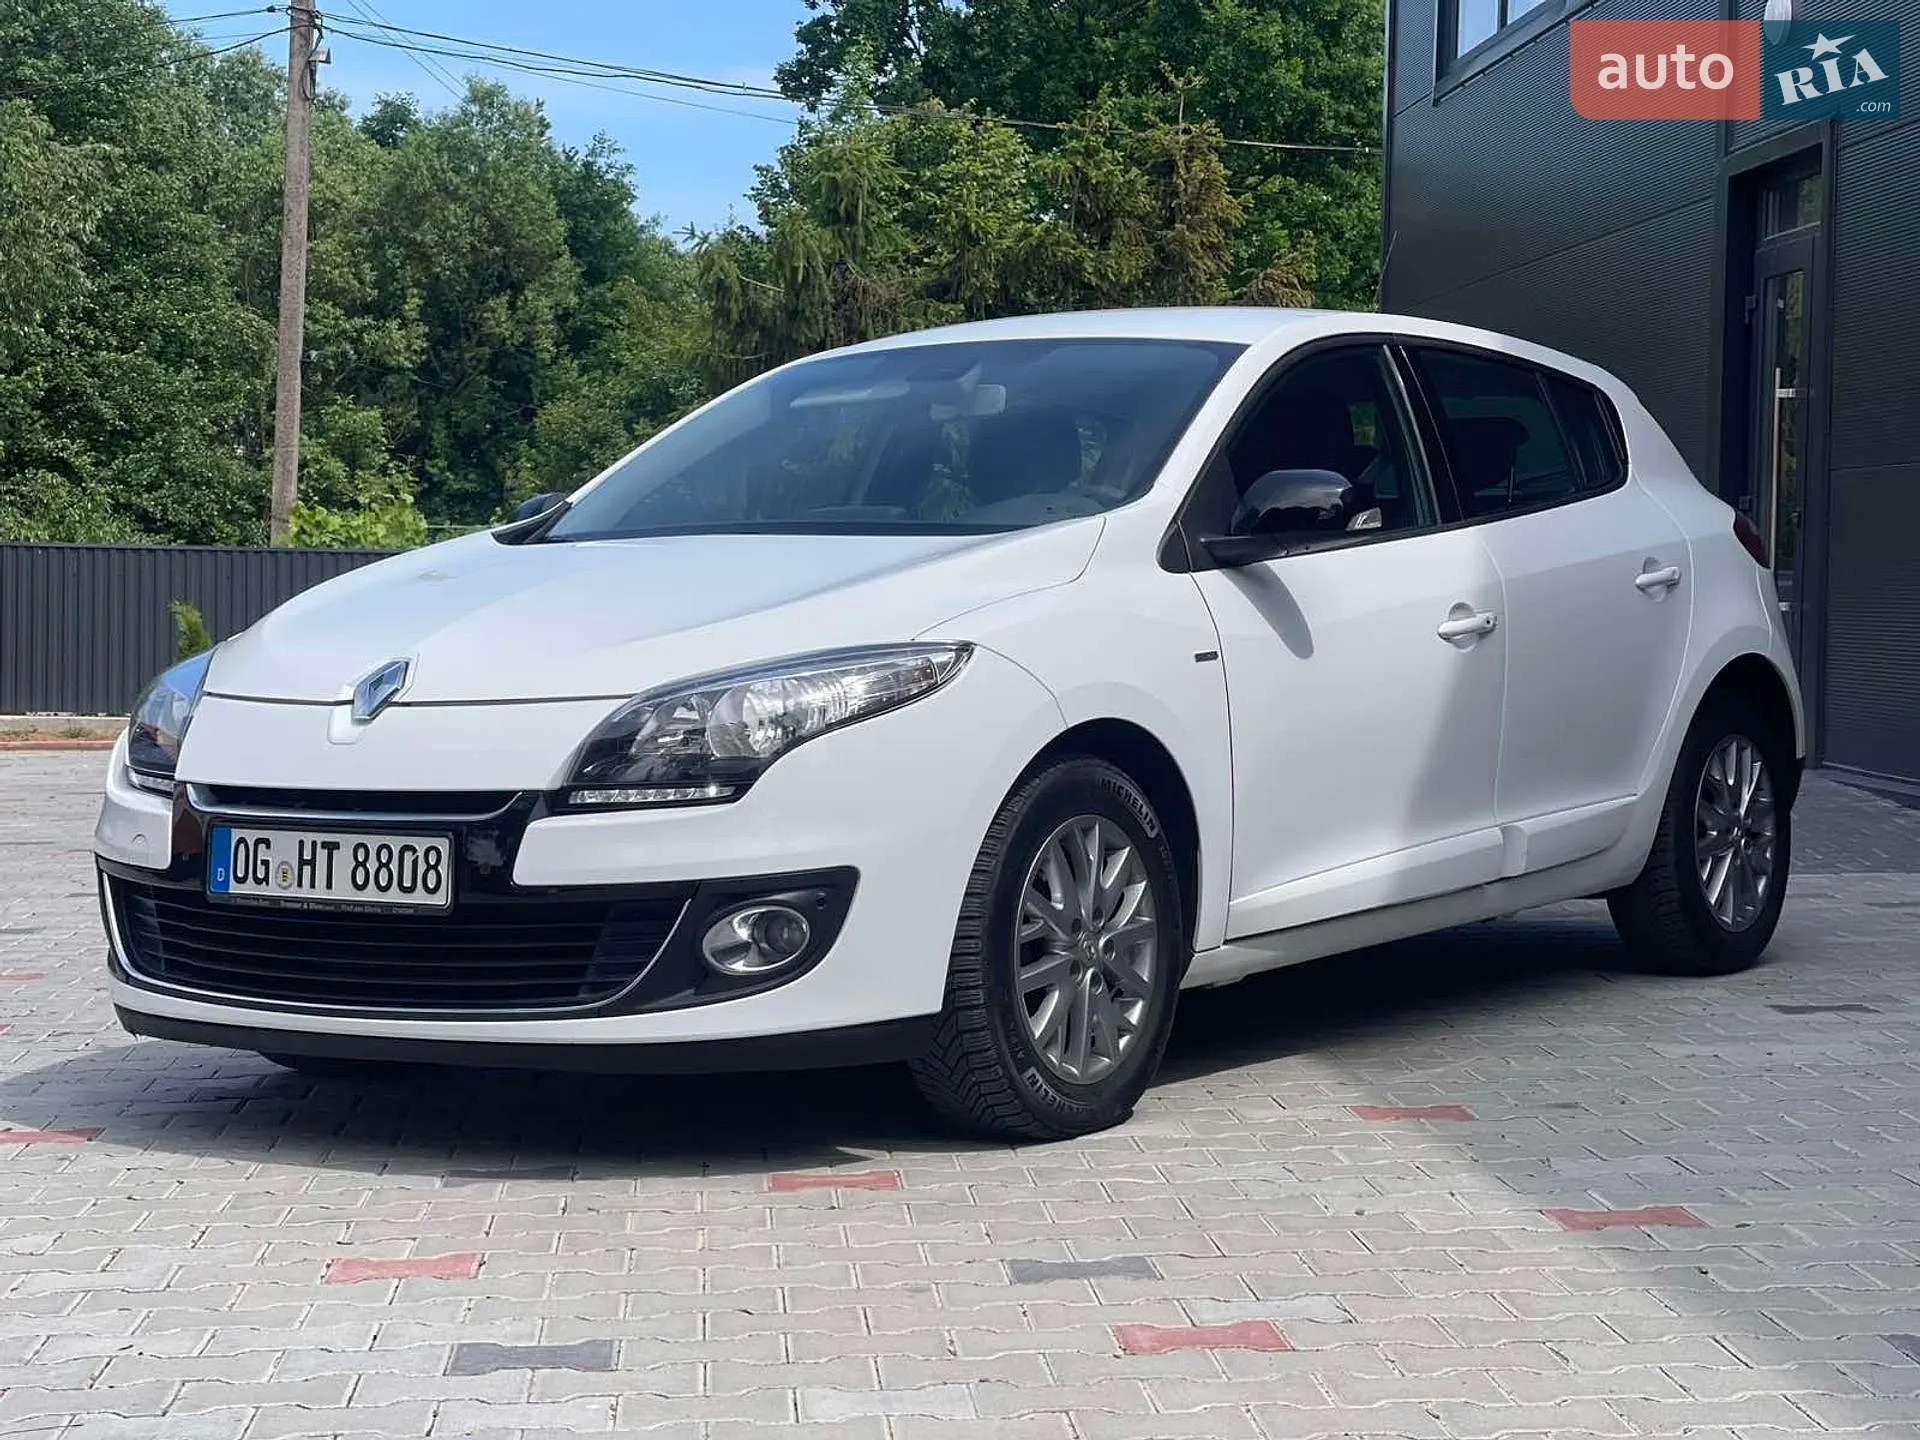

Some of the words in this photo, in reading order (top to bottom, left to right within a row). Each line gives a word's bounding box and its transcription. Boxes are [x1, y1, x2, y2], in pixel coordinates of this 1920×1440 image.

[217, 867, 225, 882] D
[232, 836, 271, 886] OG
[297, 839, 340, 890] HT
[351, 842, 443, 894] 8808
